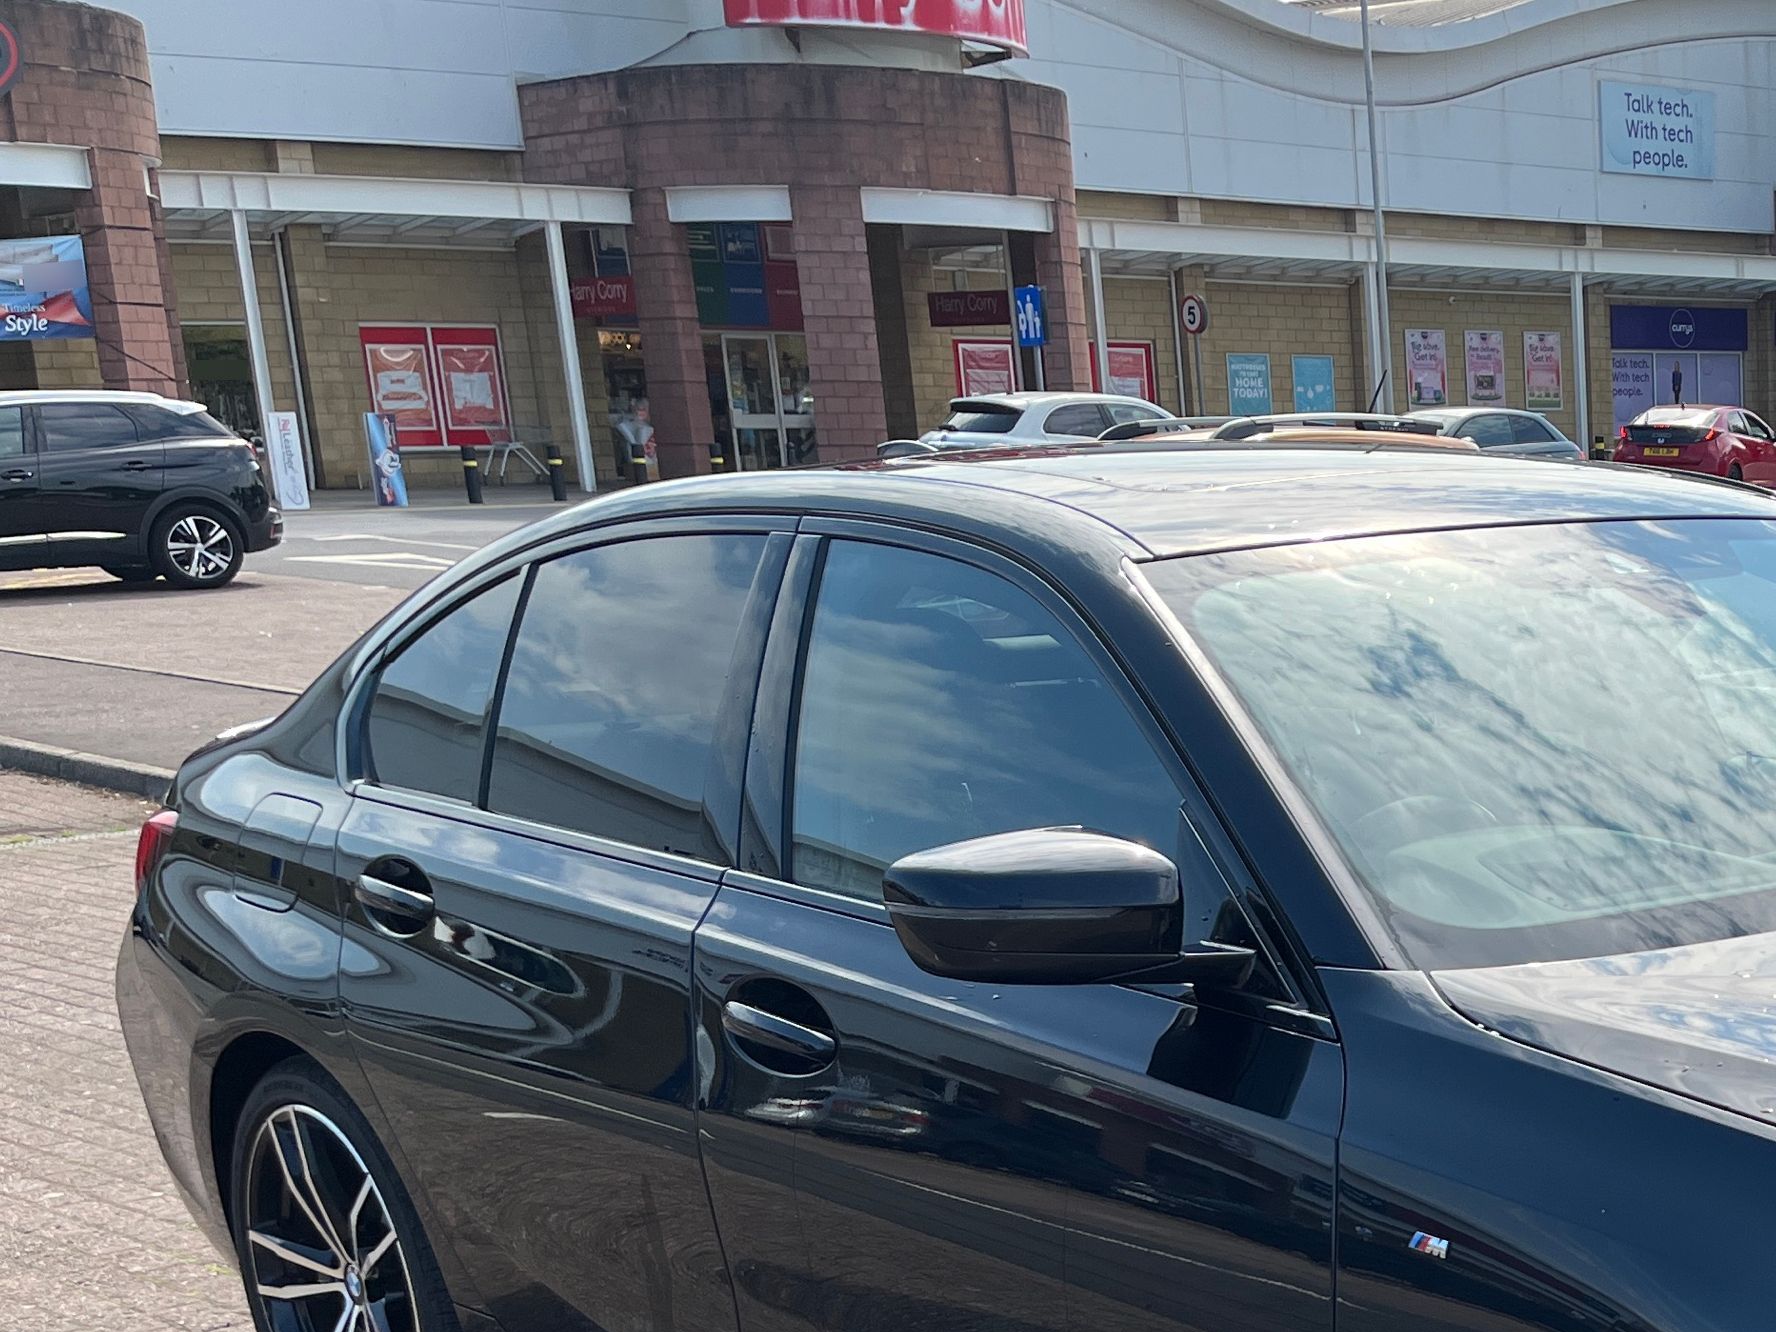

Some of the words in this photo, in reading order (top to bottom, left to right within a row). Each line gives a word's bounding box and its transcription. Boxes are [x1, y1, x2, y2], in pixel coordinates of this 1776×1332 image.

[1624, 93, 1654, 114] Talk
[1657, 97, 1693, 118] tech.
[1625, 118, 1658, 140] With
[1662, 123, 1693, 143] tech
[1633, 148, 1688, 171] people.
[597, 280, 627, 303] Corry
[967, 294, 997, 314] Corry
[5, 314, 48, 336] Style
[1187, 306, 1196, 325] 5
[1672, 324, 1693, 334] currys
[1612, 358, 1629, 368] Talk
[1235, 377, 1264, 388] HOME
[1632, 373, 1649, 382] tech
[1233, 388, 1268, 398] TODAY!
